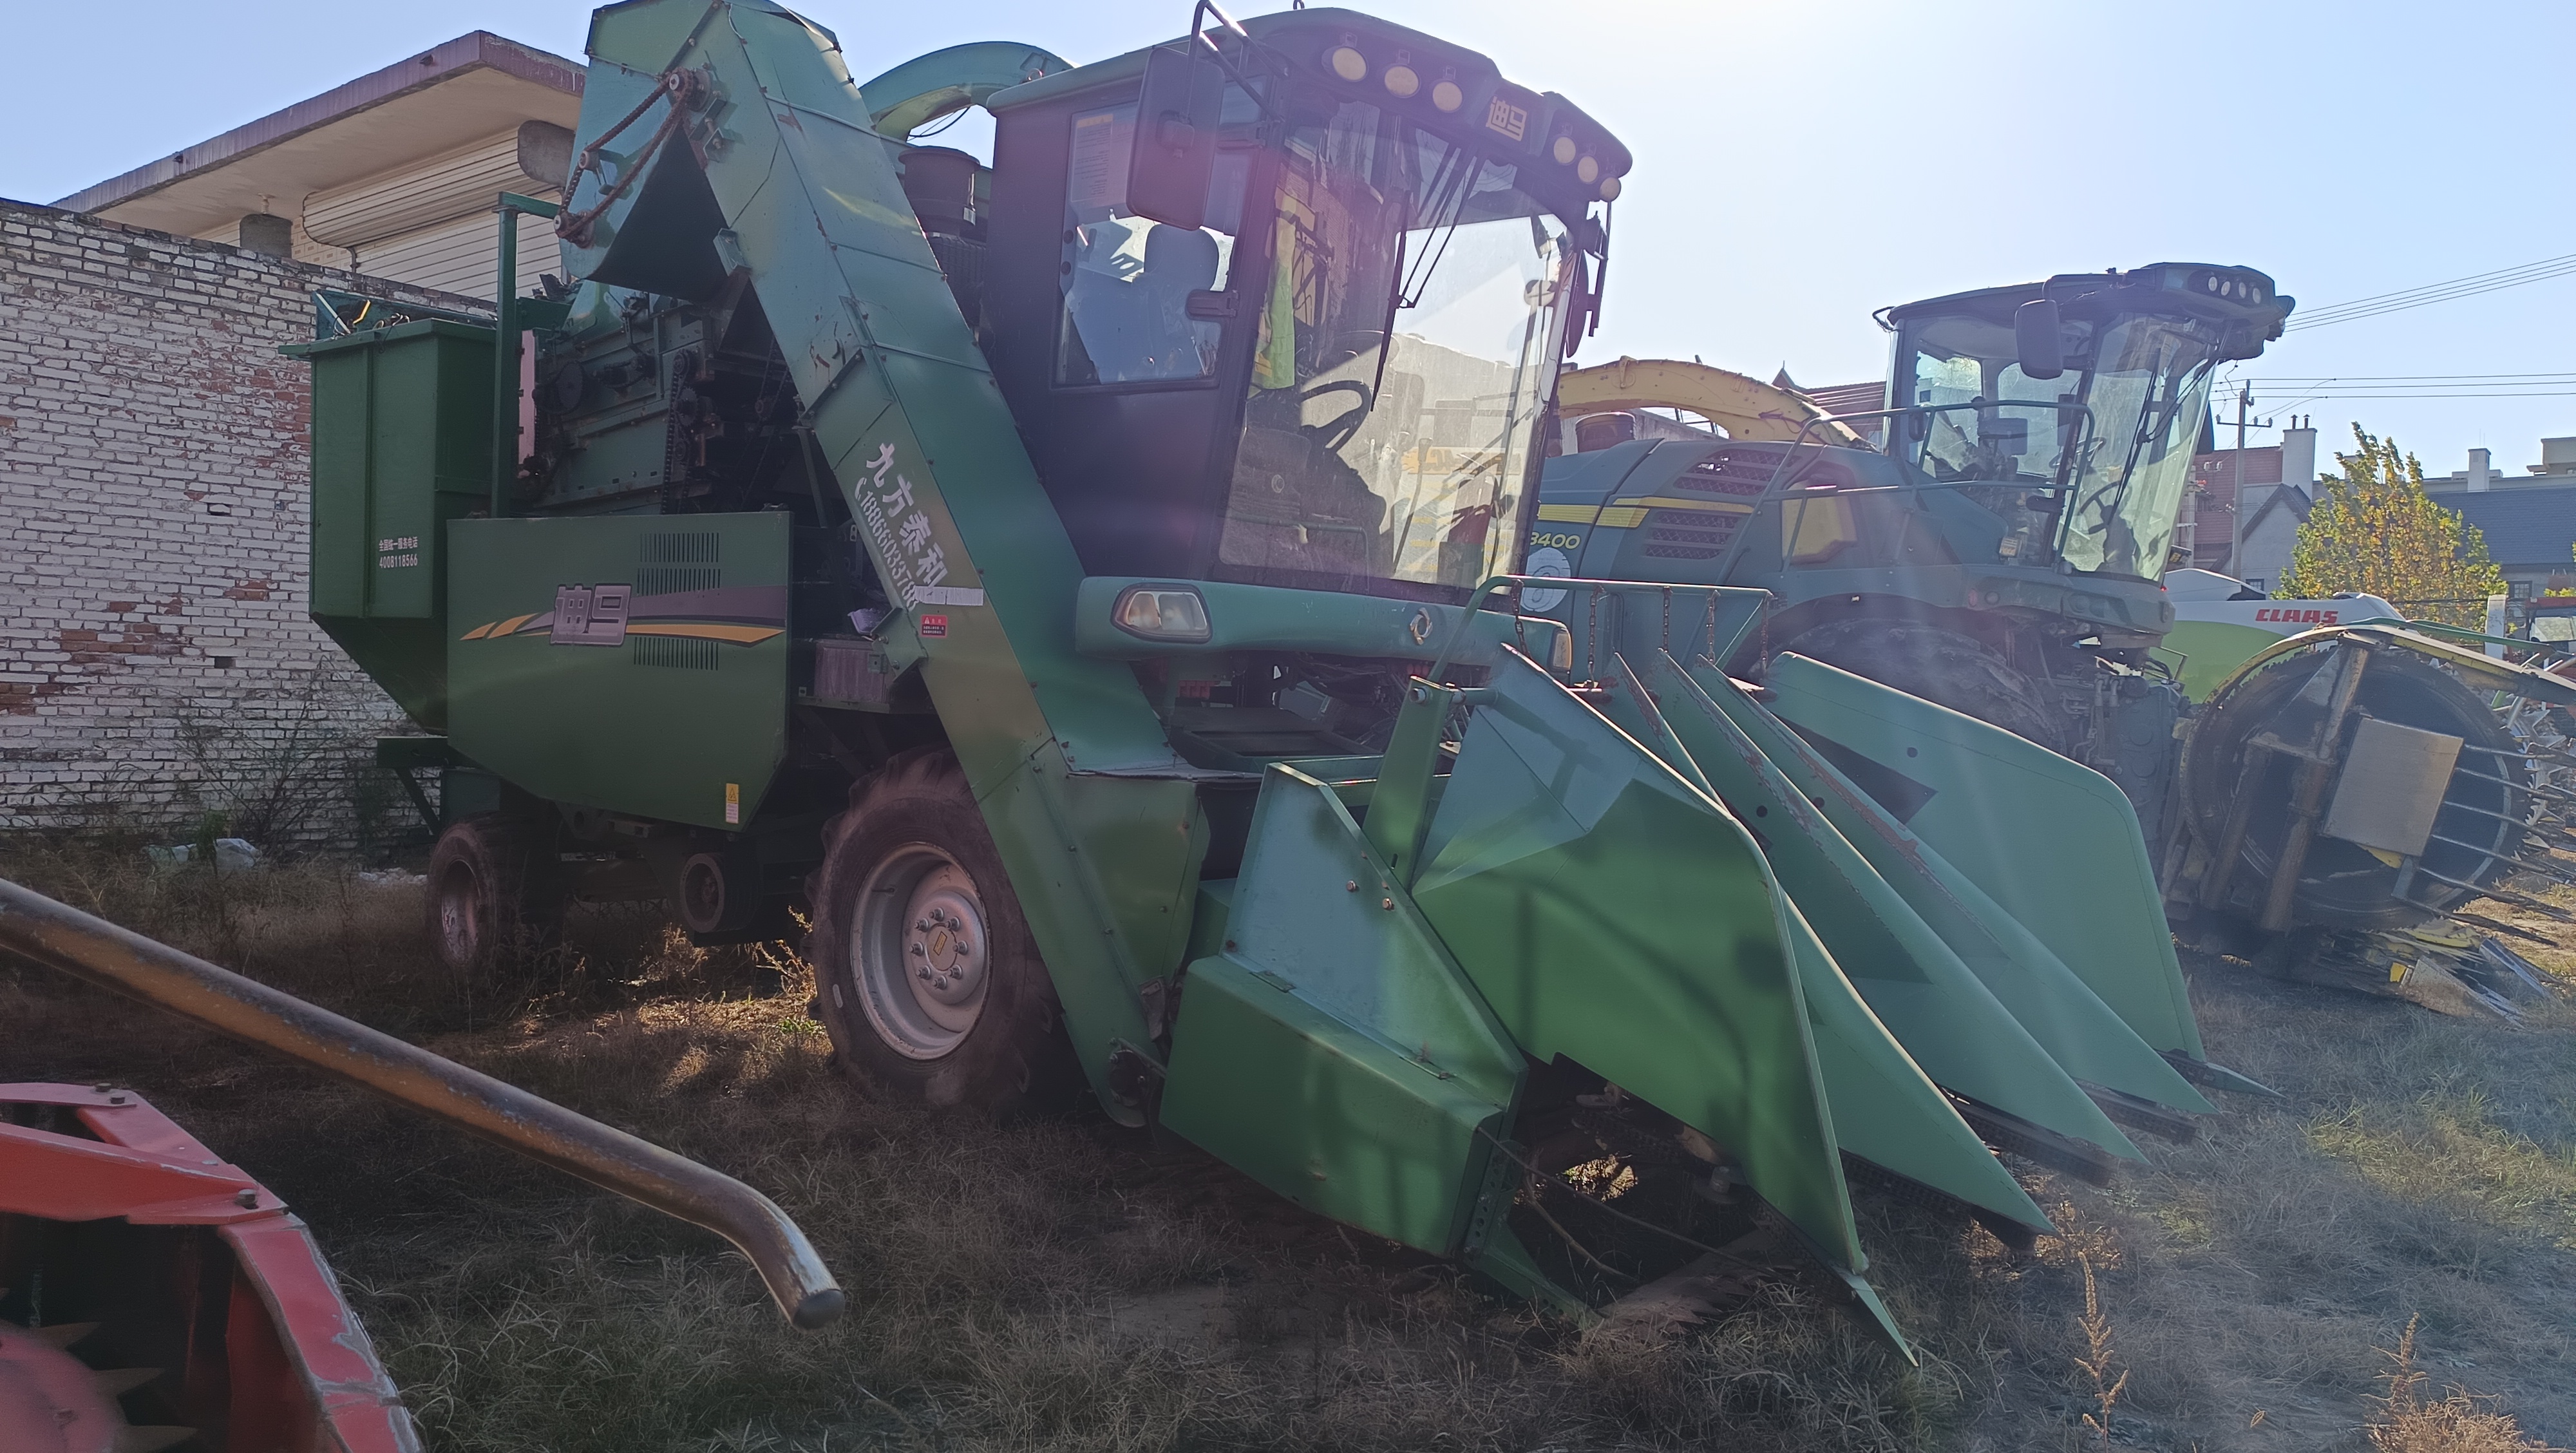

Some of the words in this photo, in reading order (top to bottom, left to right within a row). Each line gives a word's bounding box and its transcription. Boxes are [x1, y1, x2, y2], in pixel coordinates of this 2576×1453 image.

[379, 536, 418, 551] 全国统一服务电话
[379, 554, 418, 568] 4008118566
[2255, 609, 2338, 623] CLAAS
